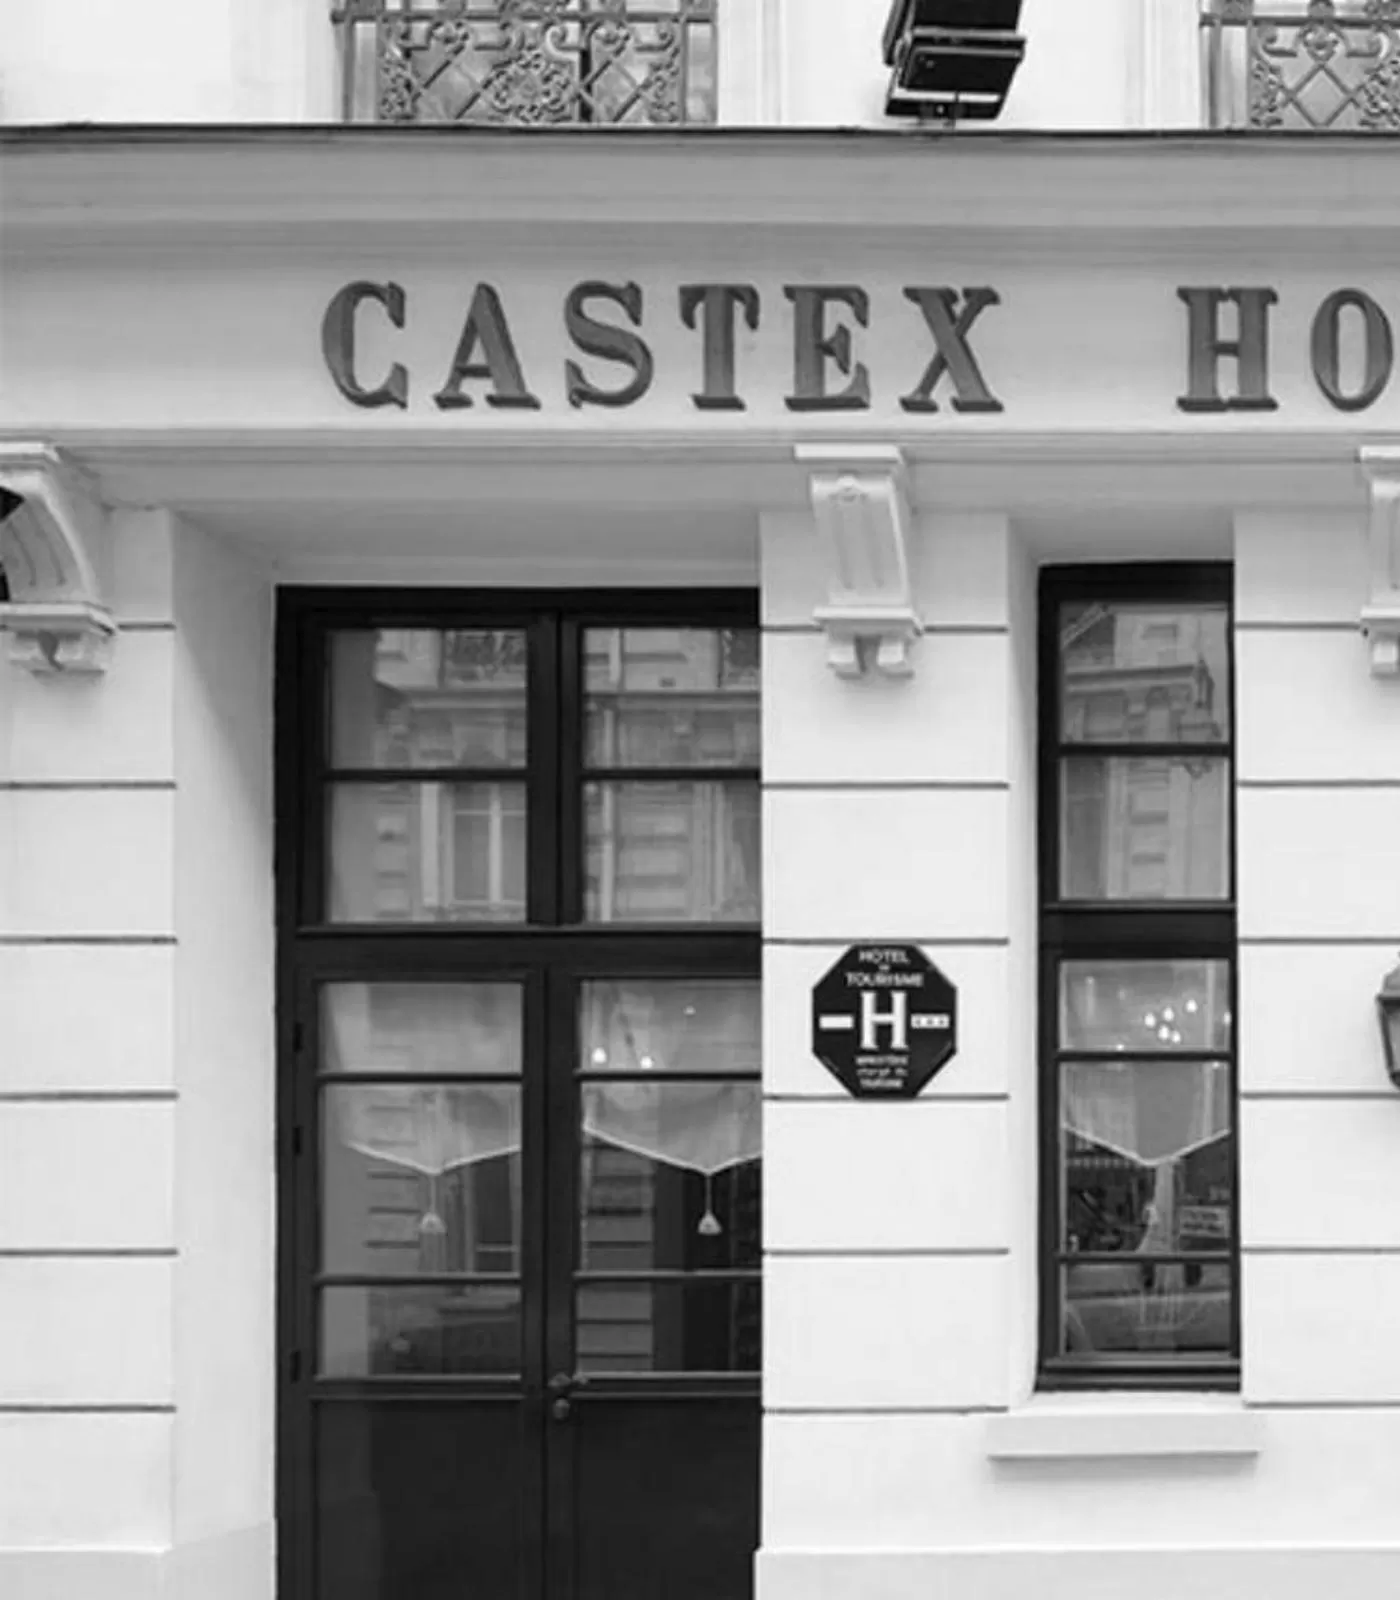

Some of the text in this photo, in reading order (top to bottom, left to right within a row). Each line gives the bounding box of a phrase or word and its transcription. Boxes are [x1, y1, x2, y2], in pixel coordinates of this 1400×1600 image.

[320, 279, 1005, 413] CASTEX
[846, 972, 924, 987] TOURISME
[860, 990, 908, 1049] H
